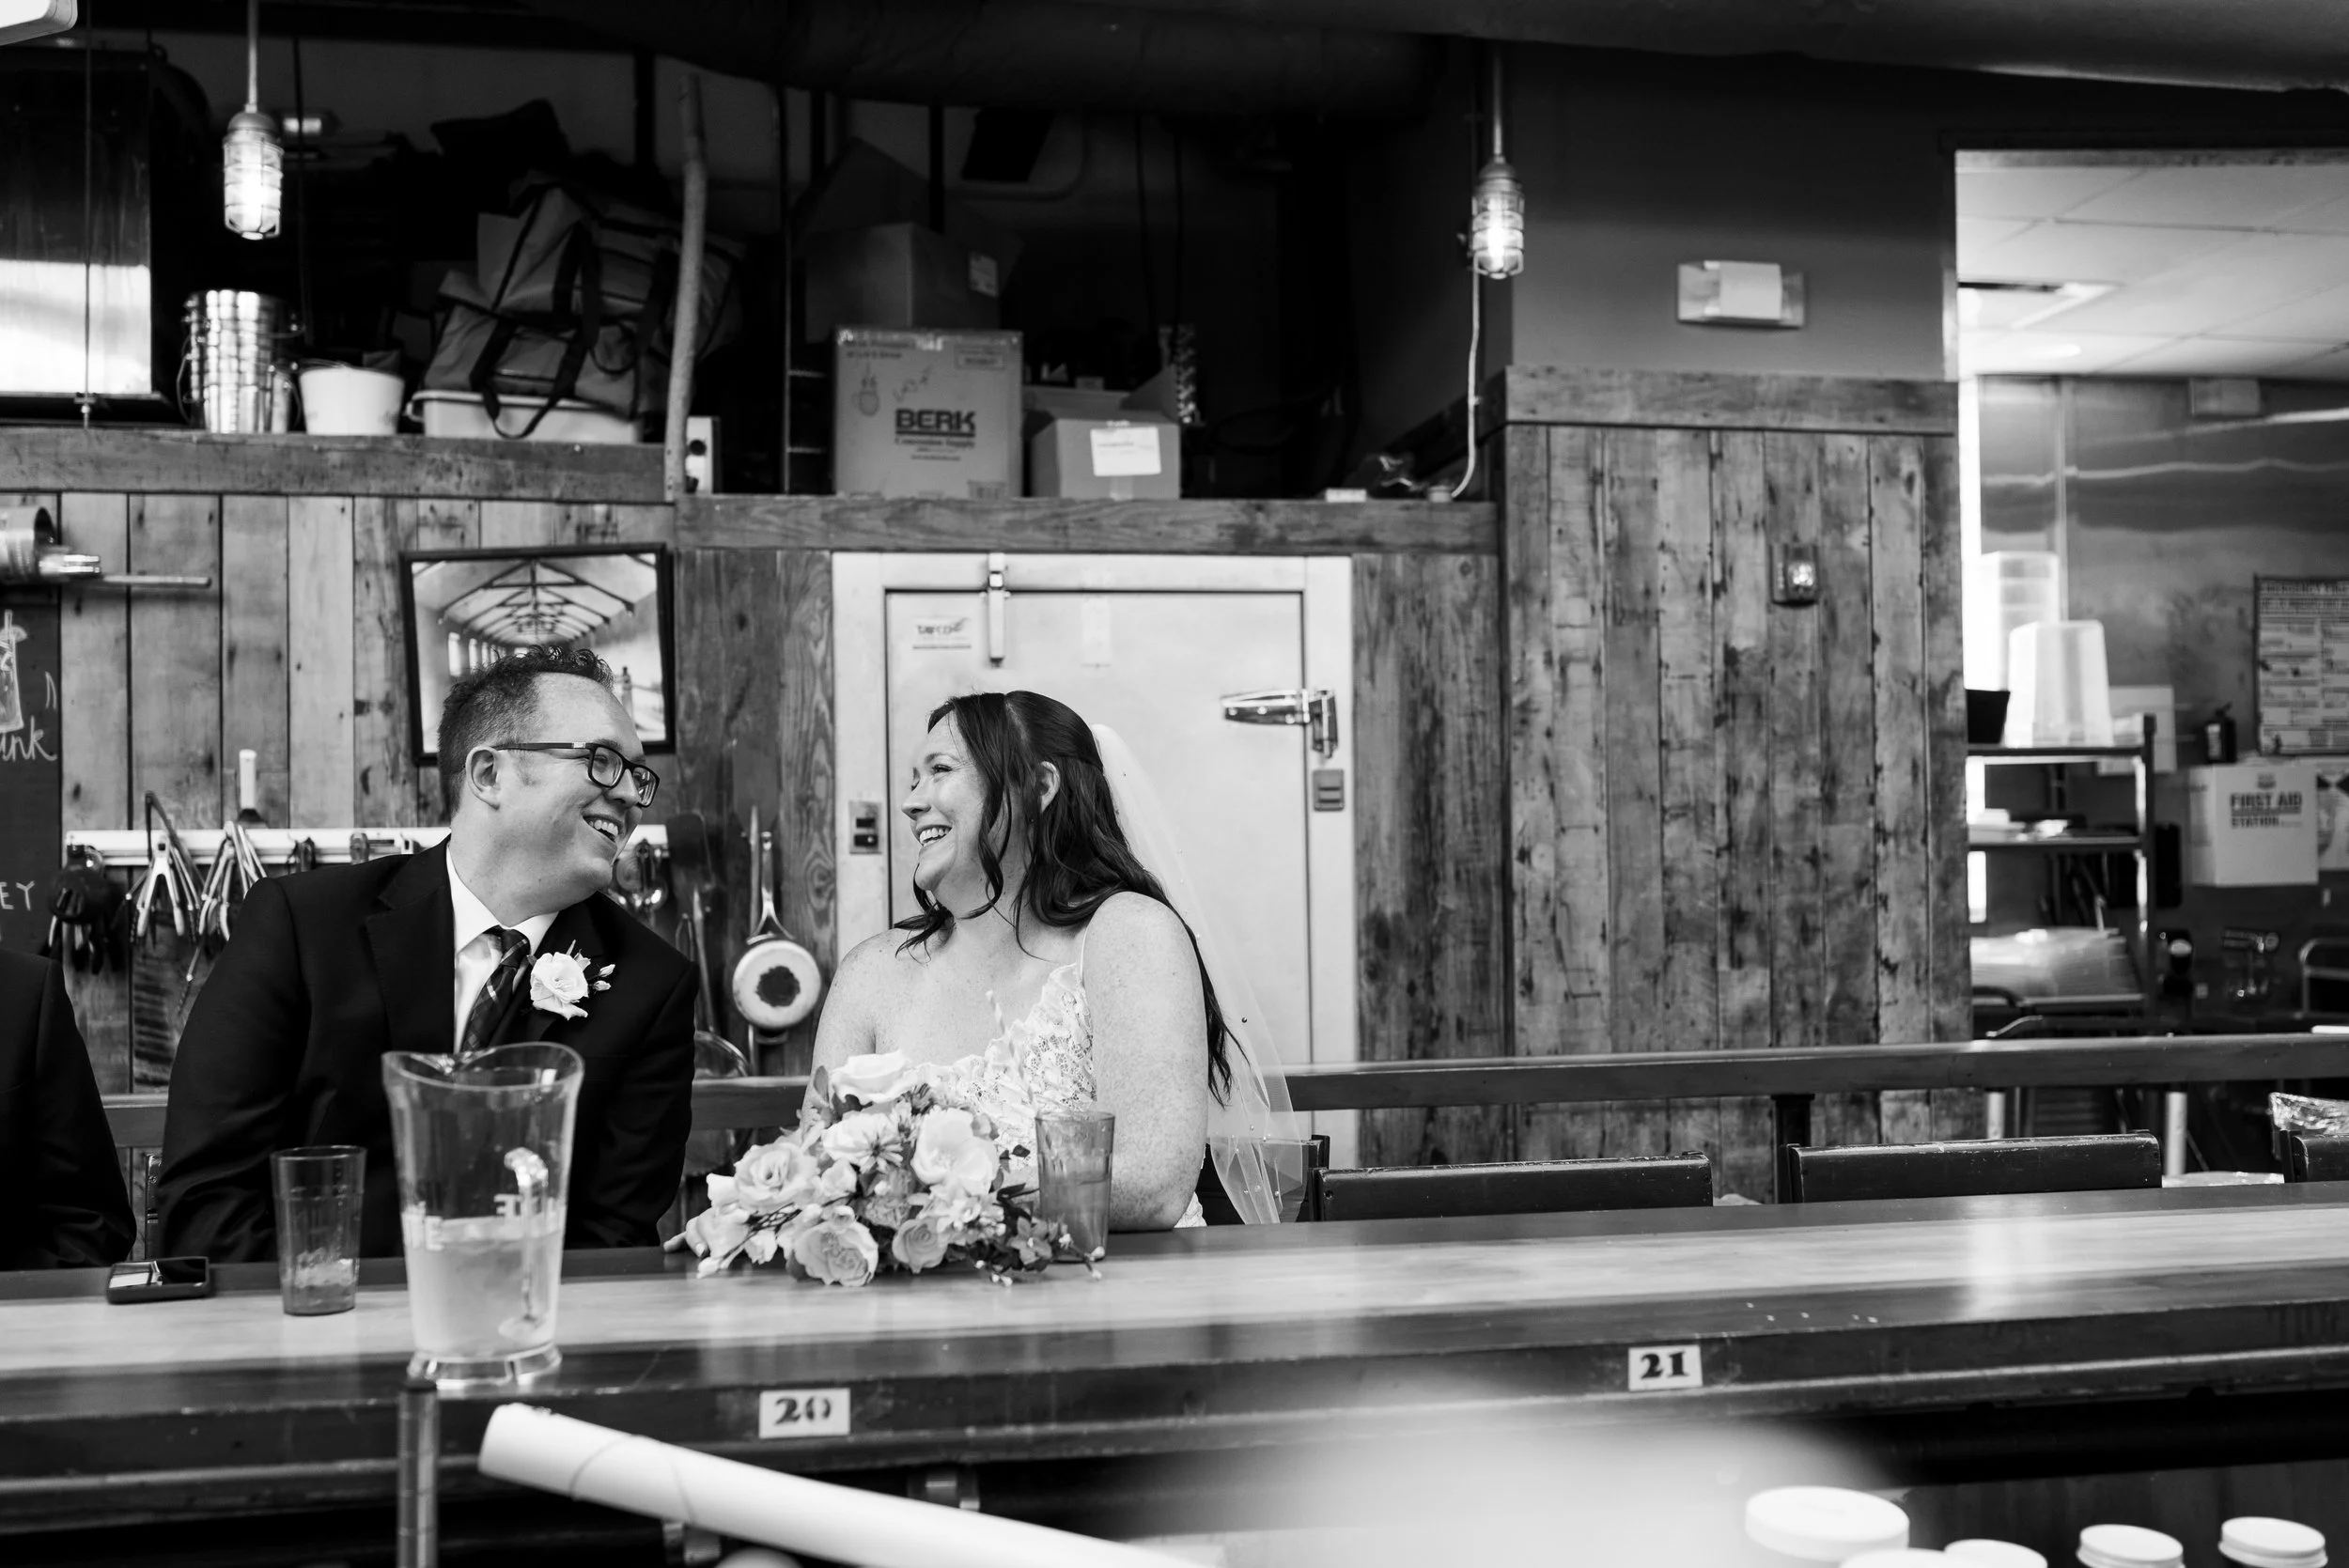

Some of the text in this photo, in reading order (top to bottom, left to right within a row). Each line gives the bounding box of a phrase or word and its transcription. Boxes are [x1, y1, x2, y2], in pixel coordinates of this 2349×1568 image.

[895, 408, 976, 431] BERK
[2231, 791, 2302, 810] FIRST AID
[1640, 1351, 1689, 1380] 21
[773, 1396, 832, 1425] 20
